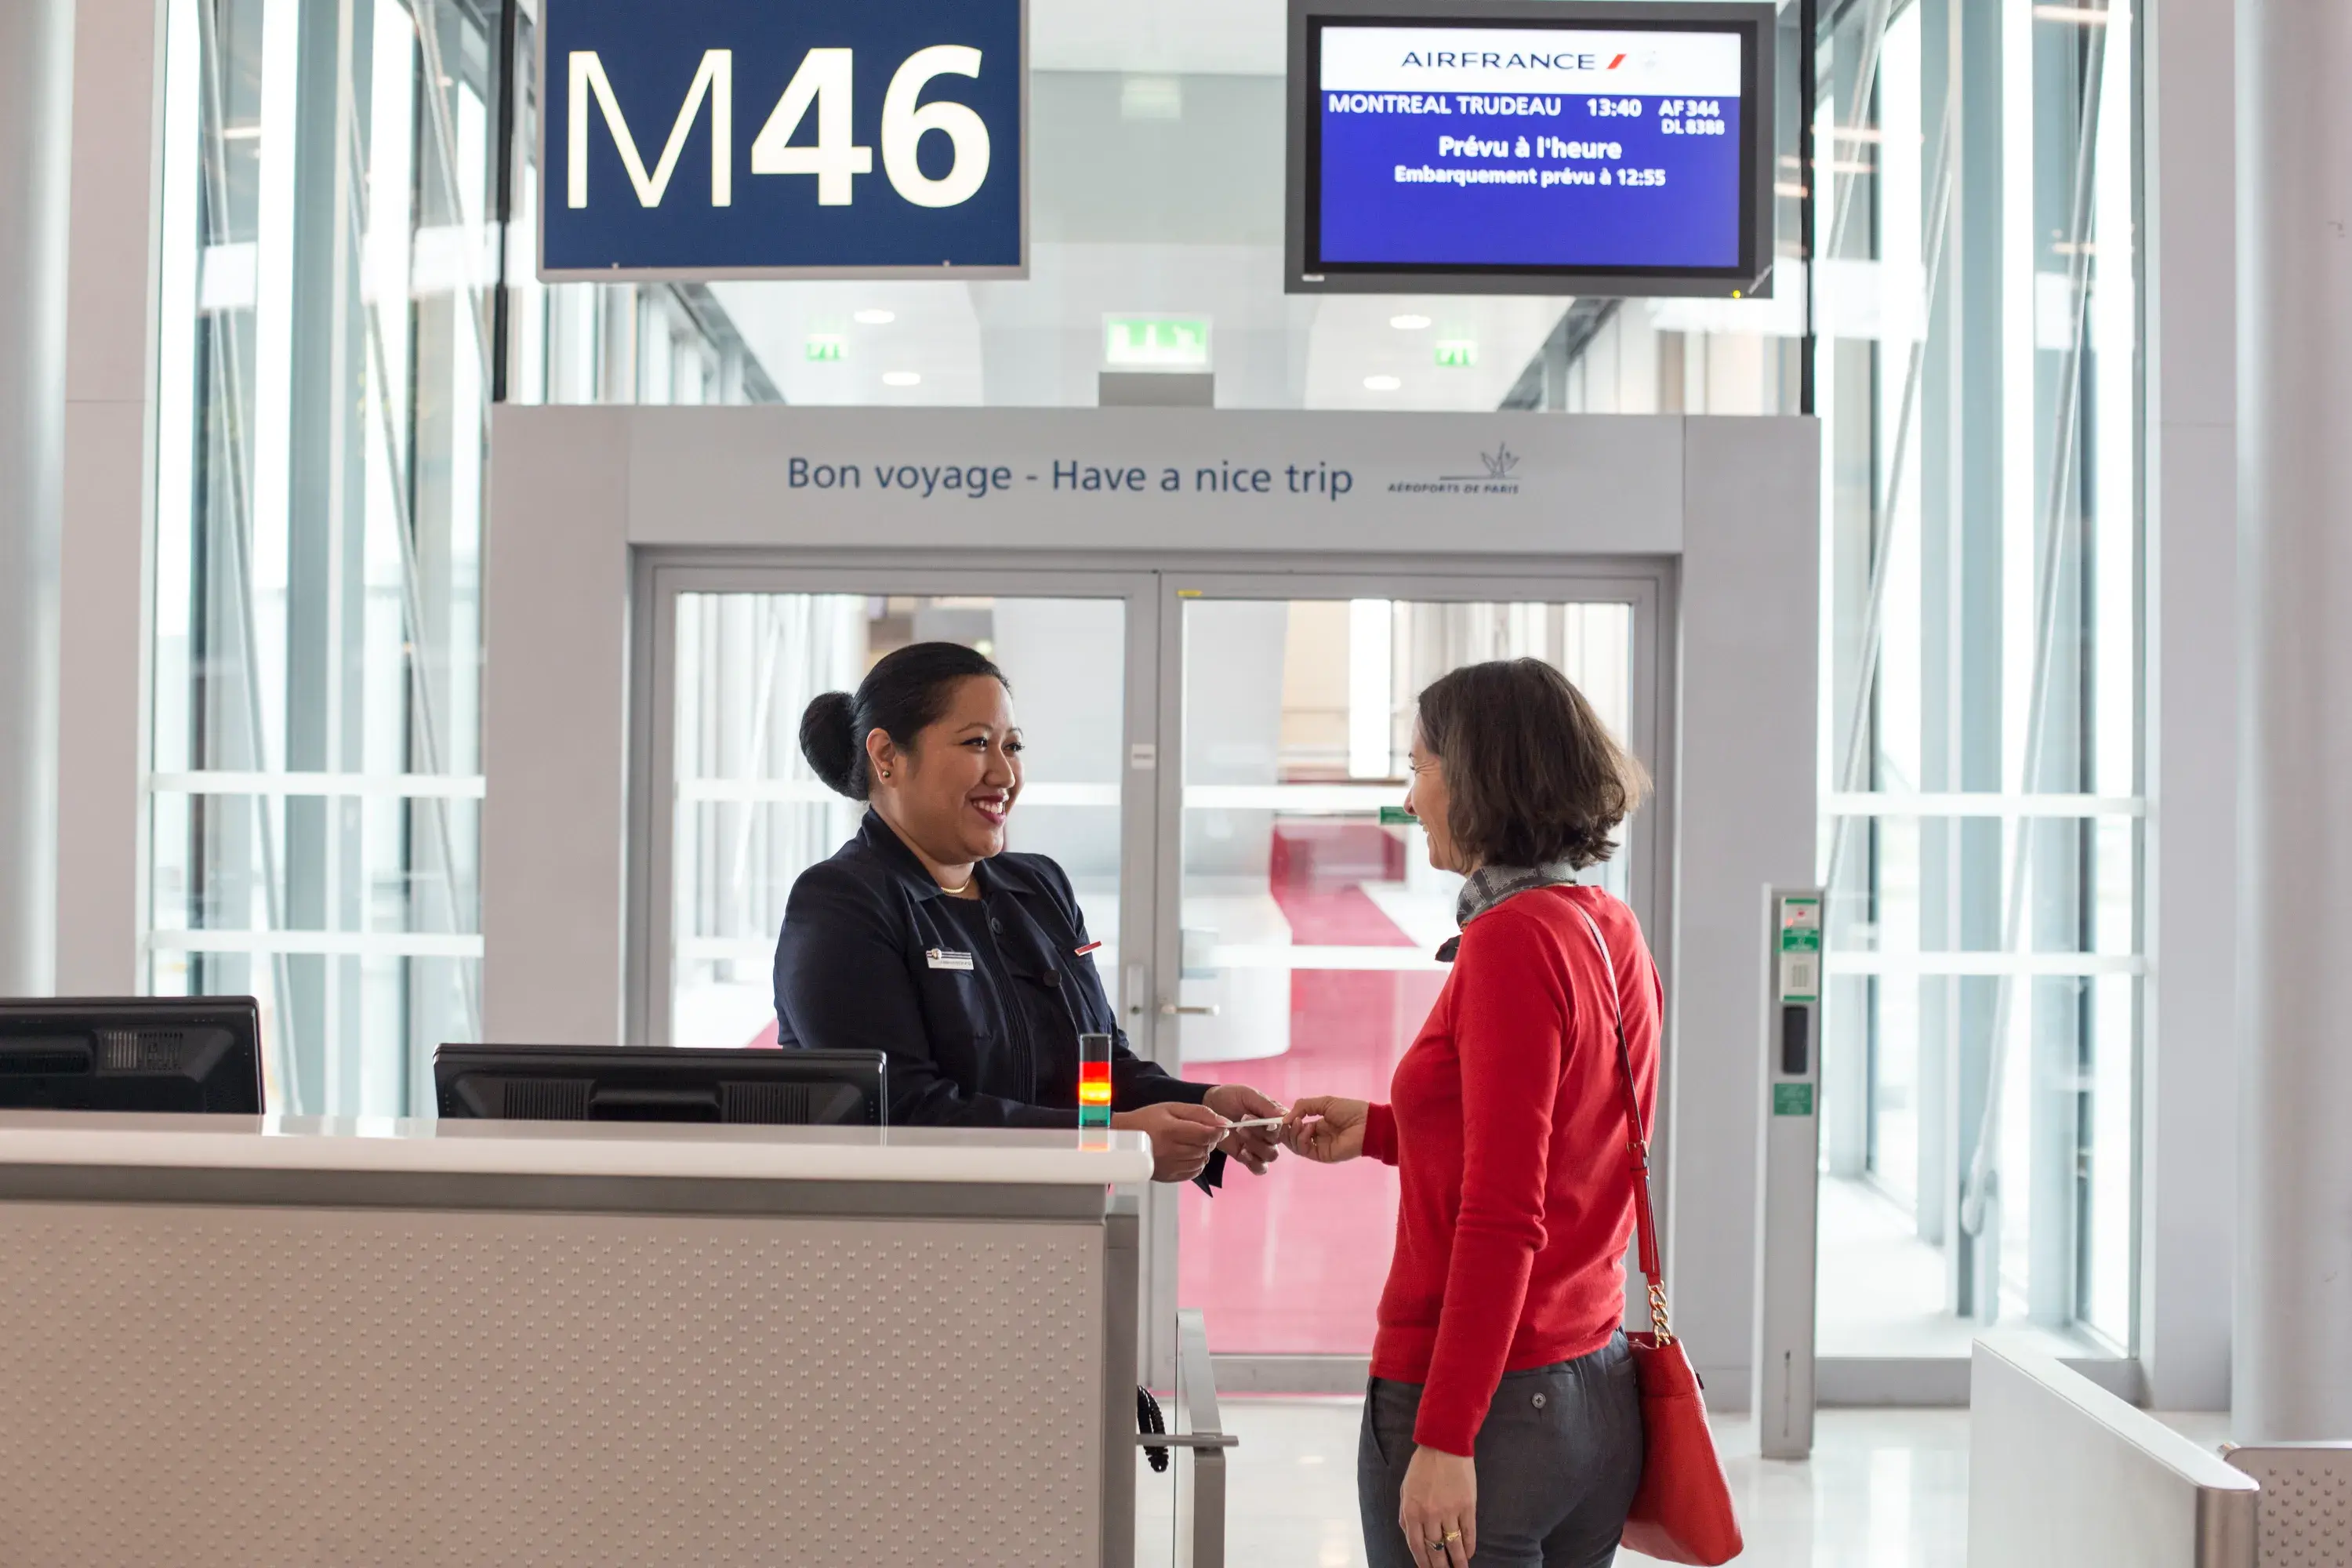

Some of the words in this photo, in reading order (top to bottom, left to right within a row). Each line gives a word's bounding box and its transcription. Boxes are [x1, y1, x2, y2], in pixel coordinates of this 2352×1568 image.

[1402, 51, 1595, 70] AIRFRANCE
[1329, 94, 1451, 114] MONTREAL
[1457, 95, 1561, 116] TRUDEAU
[1587, 98, 1642, 118] 13:40
[1658, 99, 1684, 117] AF
[1686, 100, 1720, 118] 344
[568, 44, 990, 209] M46
[1661, 118, 1685, 135] DL
[1439, 135, 1508, 158] Prévu
[1515, 136, 1530, 158] à
[1537, 136, 1623, 160] l'heure
[1394, 165, 1537, 187] Embarquement
[1541, 165, 1595, 189] prévu
[1599, 166, 1611, 186] à
[1617, 168, 1666, 187] 12:55
[789, 457, 860, 488] Bon
[875, 466, 1011, 499] voyage
[1053, 459, 1146, 492] Have
[1160, 468, 1180, 492] a
[1196, 460, 1272, 493] nice
[1284, 461, 1353, 502] trip
[1463, 484, 1480, 494] DE
[1483, 484, 1519, 495] PARIS
